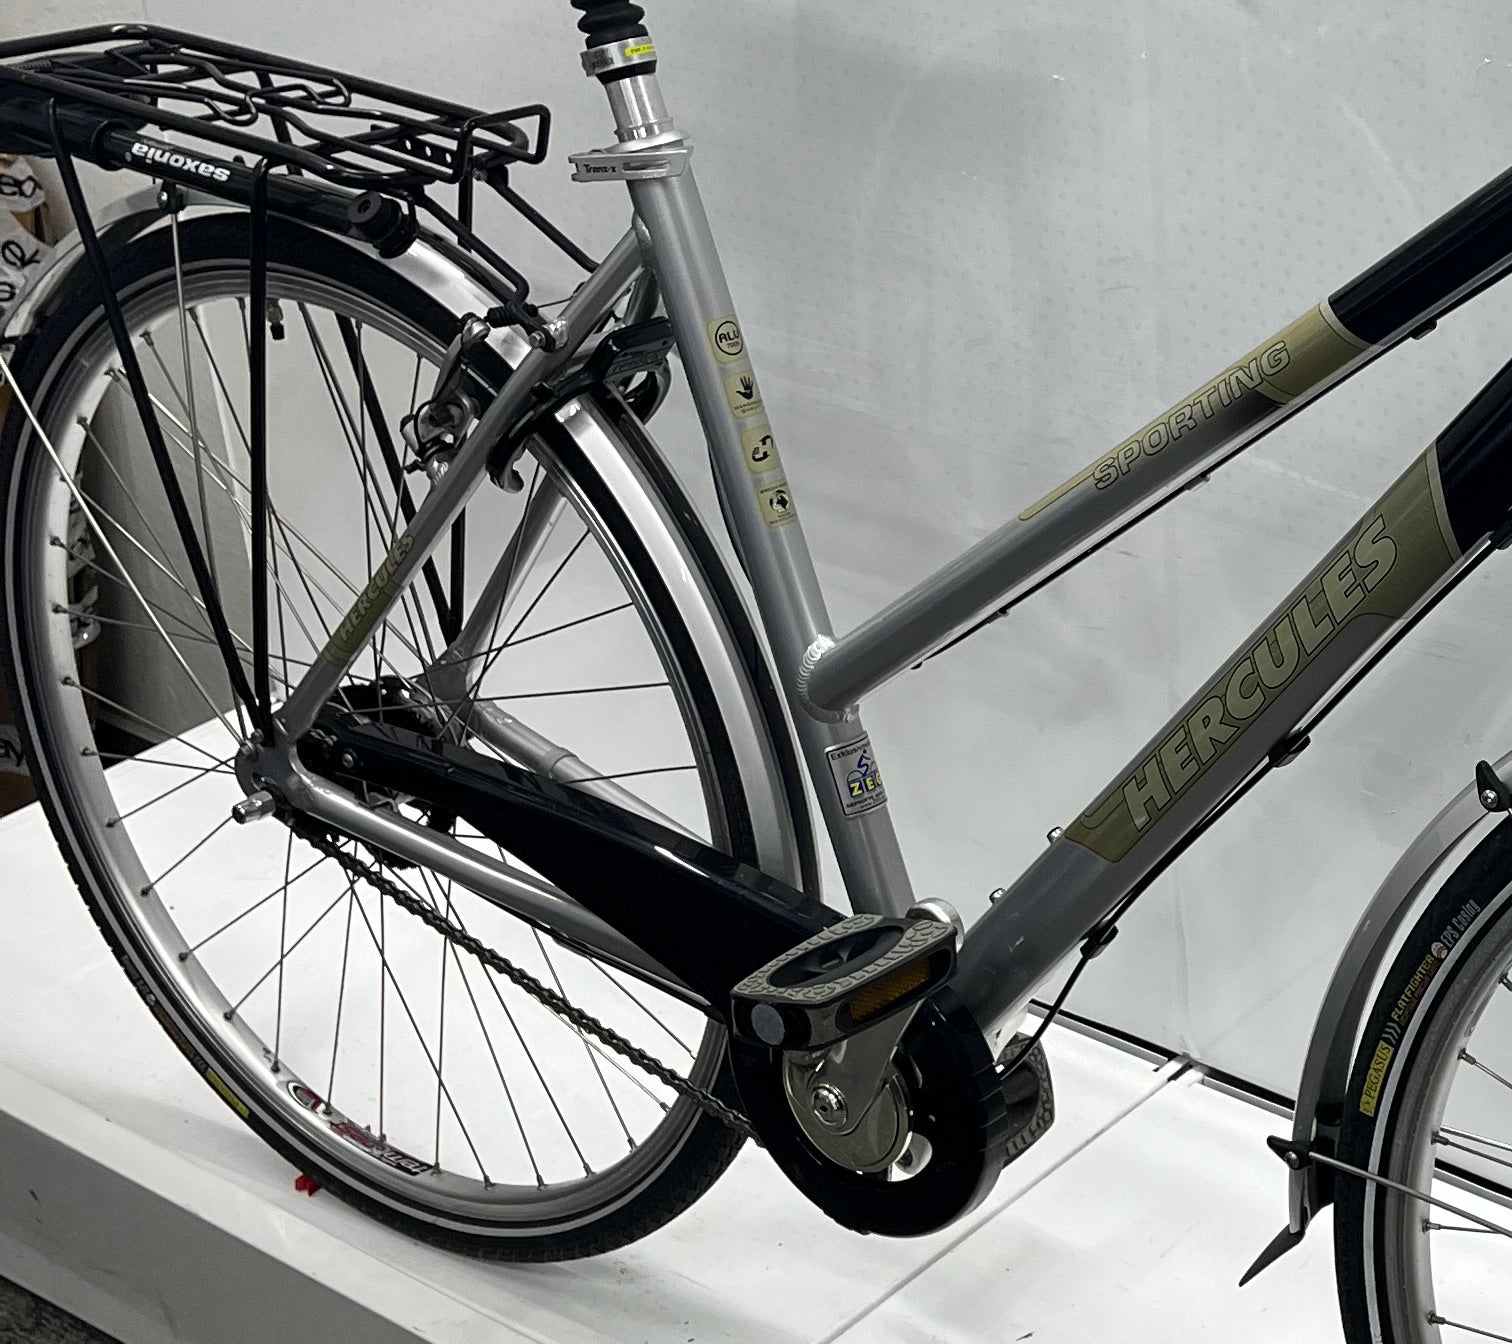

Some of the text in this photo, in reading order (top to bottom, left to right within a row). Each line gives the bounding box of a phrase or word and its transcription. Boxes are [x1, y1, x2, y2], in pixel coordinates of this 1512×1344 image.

[131, 142, 231, 182] saxonia
[719, 329, 740, 343] ALU
[1093, 340, 1290, 490] SPORTING
[340, 535, 415, 642] HERCULES
[1122, 513, 1398, 833] HERCULES
[1391, 954, 1434, 1022] FLATFIGHTER
[1364, 1043, 1392, 1100] PEGASUS
